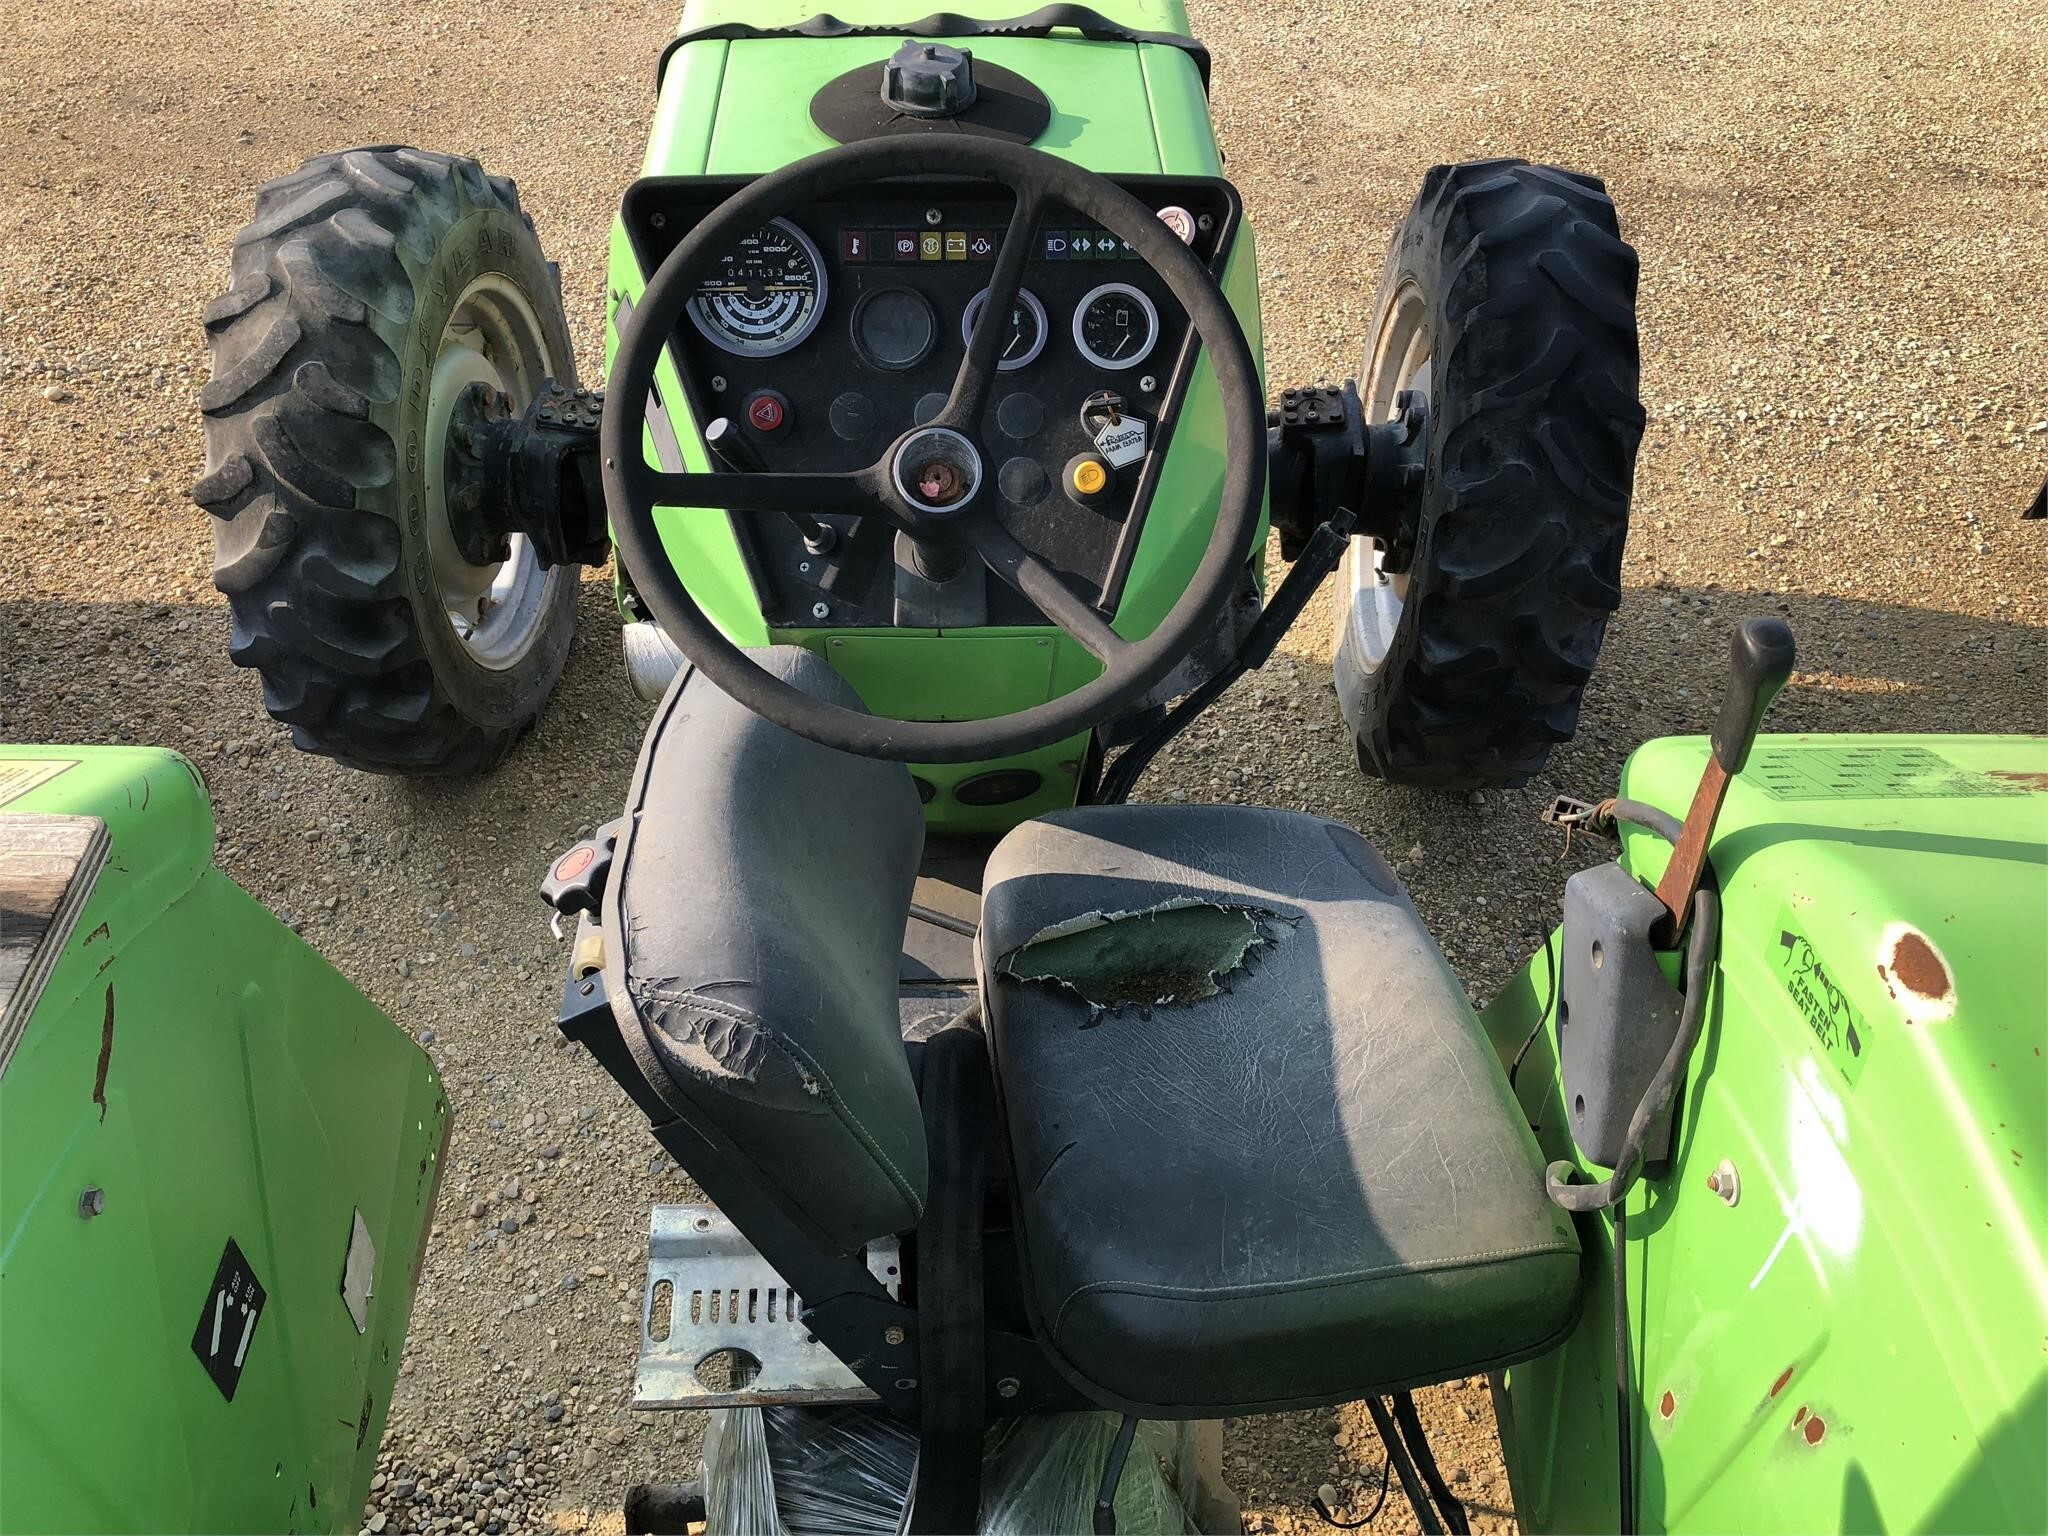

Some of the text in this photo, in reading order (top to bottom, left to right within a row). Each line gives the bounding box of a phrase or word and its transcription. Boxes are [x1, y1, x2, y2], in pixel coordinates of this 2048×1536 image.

[1788, 980, 1834, 1050] SEAT BELT
[1797, 976, 1831, 1031] FASTEN
